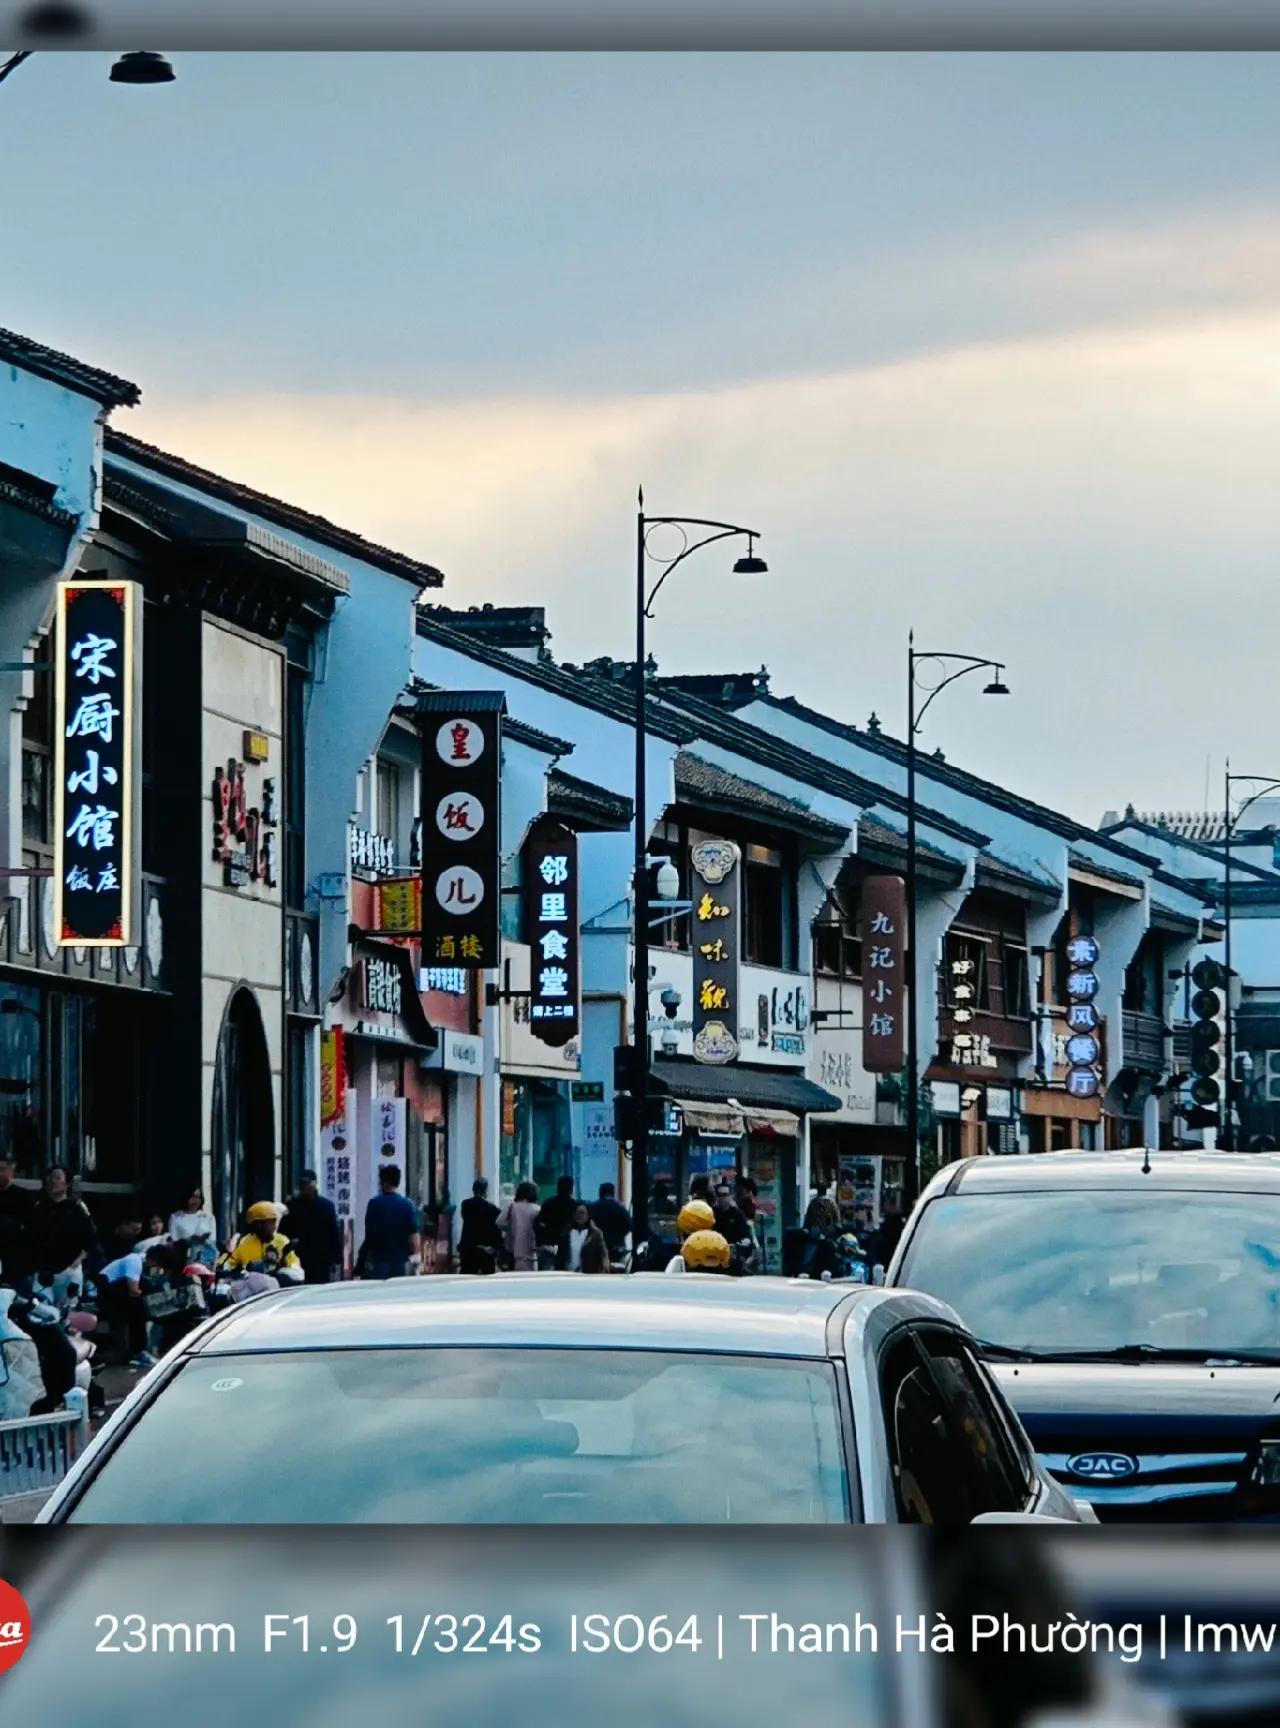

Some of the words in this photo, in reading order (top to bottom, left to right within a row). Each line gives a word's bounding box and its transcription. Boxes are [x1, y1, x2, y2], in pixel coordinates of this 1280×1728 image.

[65, 633, 120, 851] 宋厨小馆
[66, 864, 120, 895] 饭庄
[442, 723, 476, 905] 皇饭儿
[539, 855, 569, 997] 邻里食堂
[870, 911, 895, 1037] 九记小馆
[1078, 1458, 1127, 1472] JAC
